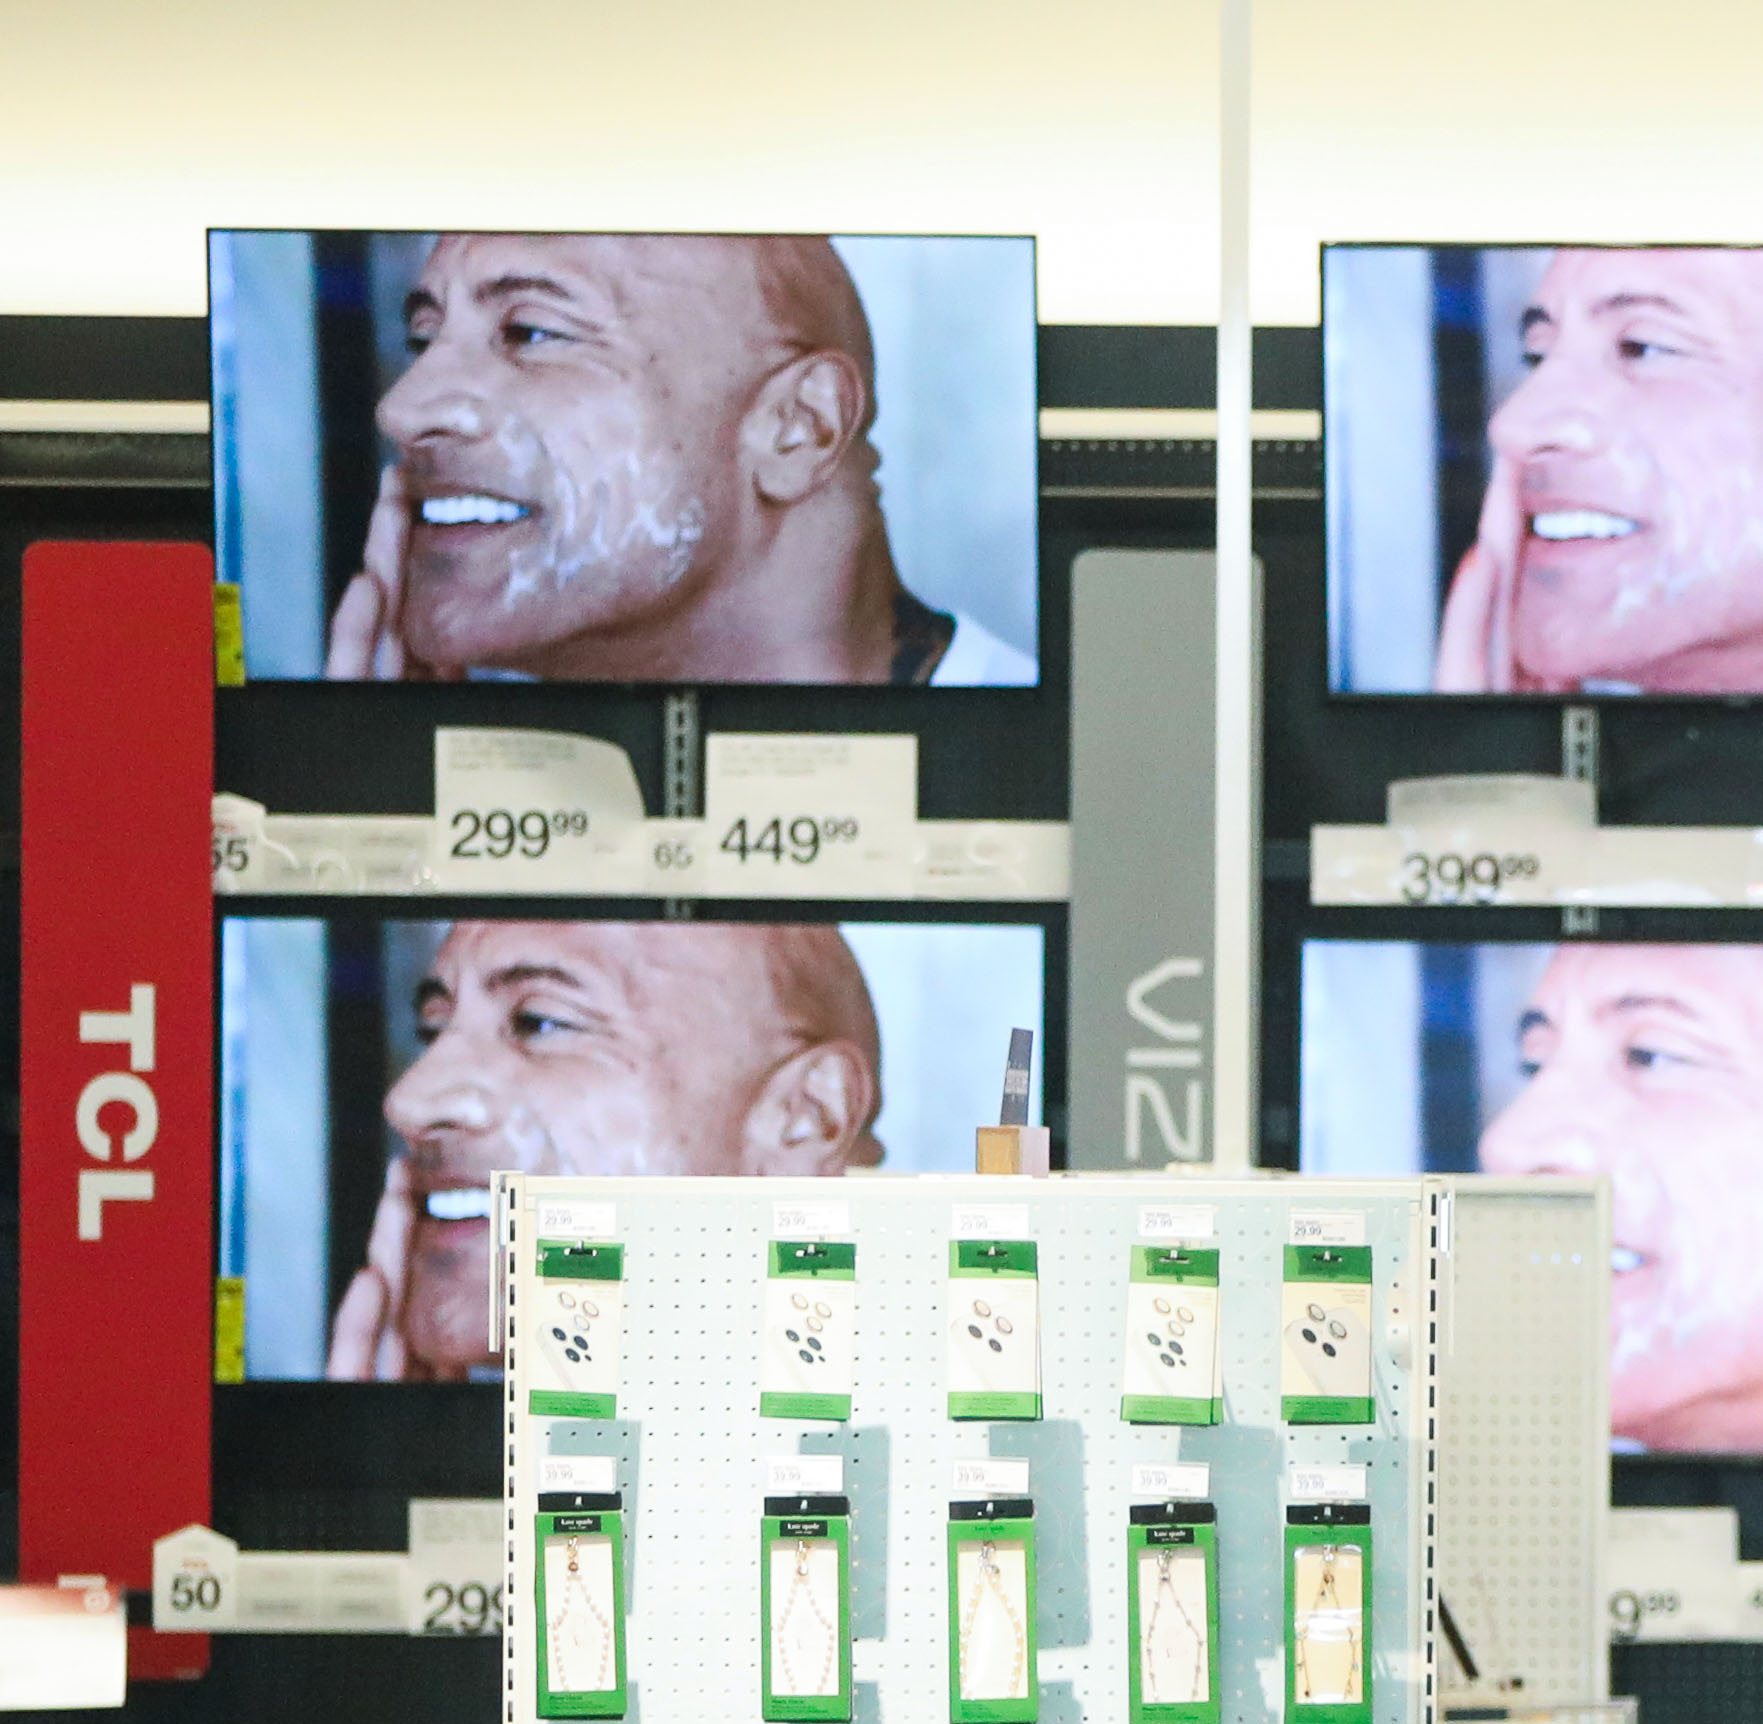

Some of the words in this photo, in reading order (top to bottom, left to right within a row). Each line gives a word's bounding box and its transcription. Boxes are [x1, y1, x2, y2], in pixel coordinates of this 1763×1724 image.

[75, 982, 159, 1240] TCL
[1125, 957, 1203, 1161] VIZ
[1293, 1225, 1322, 1237] 29.99
[170, 1572, 222, 1611] 50
